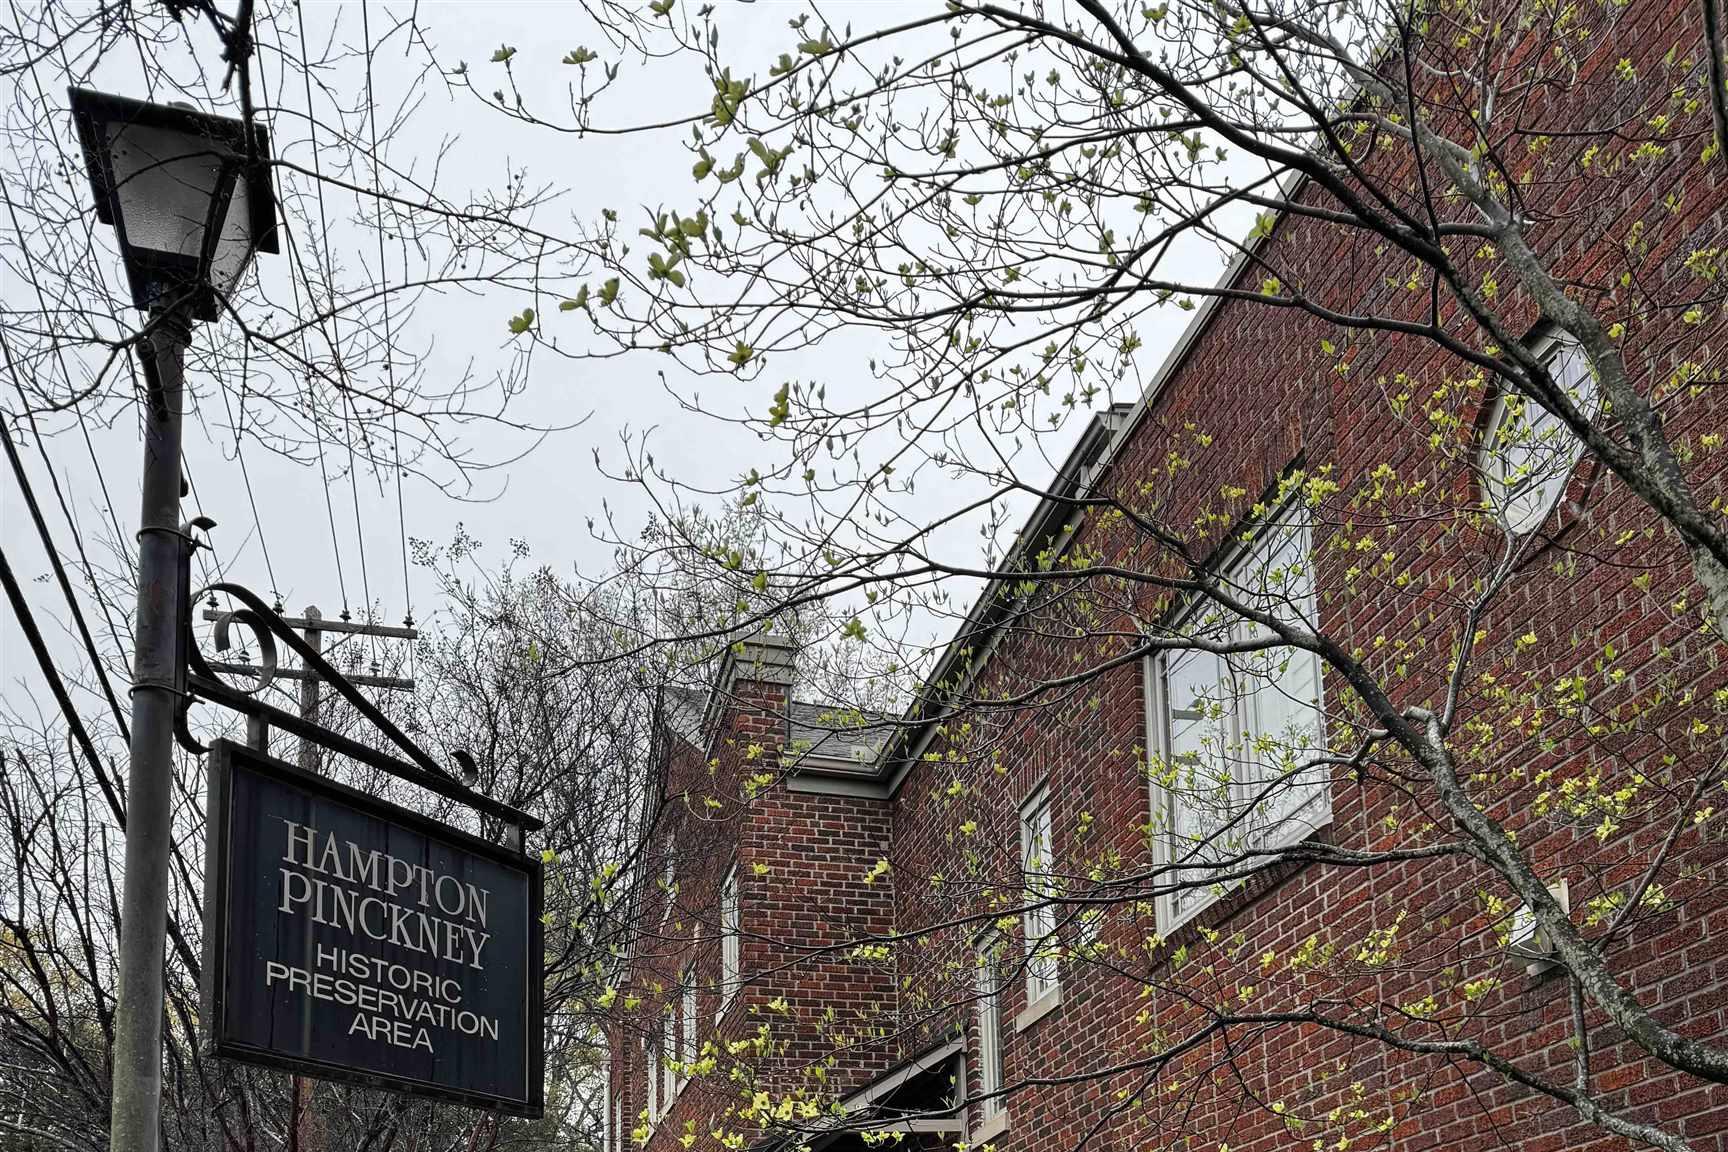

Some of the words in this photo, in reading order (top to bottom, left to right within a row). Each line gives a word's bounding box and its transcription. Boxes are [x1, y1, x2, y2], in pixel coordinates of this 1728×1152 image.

[281, 818, 491, 929] HAMPTON
[278, 867, 491, 971] PINCKNEY
[266, 961, 499, 1041] PRESERVATION
[317, 943, 462, 1004] HISTORIC
[348, 1012, 434, 1054] AREA
